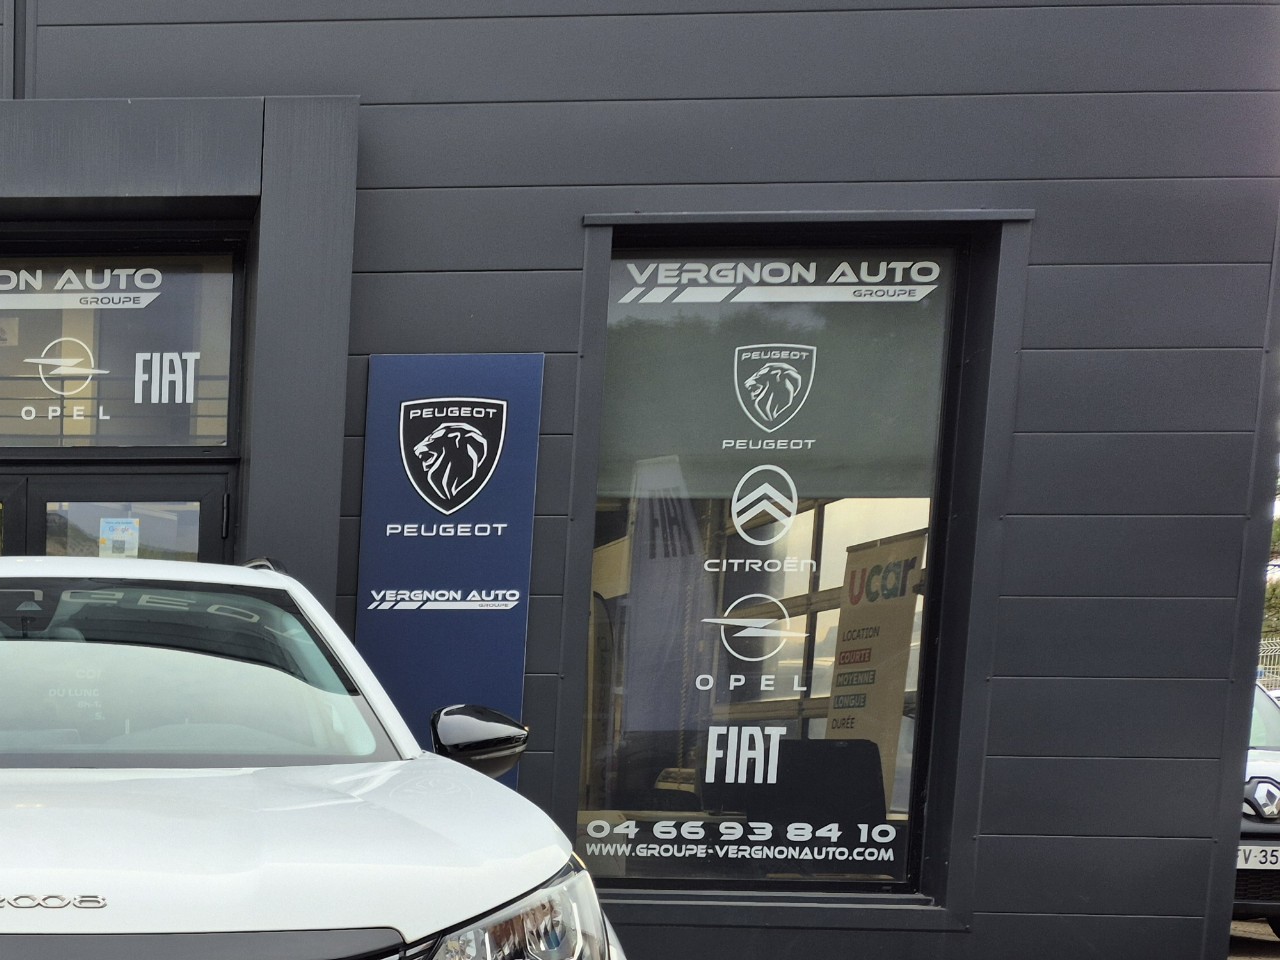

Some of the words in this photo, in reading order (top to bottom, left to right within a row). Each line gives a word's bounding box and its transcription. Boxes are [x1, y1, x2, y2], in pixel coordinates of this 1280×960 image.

[54, 267, 163, 291] AUTO
[625, 261, 818, 285] VERGNON
[826, 260, 941, 284] AUTO
[852, 288, 917, 298] GROUPE
[78, 296, 142, 306] GROUPE
[741, 350, 810, 361] PEUGEOT
[134, 351, 201, 404] FIAT
[21, 406, 111, 421] OPEL
[409, 406, 498, 420] PEUGEOT
[721, 439, 817, 450] PEUGEOT
[385, 523, 508, 537] PEUGEOT
[370, 589, 462, 601] VERGNON
[466, 589, 520, 601] AUTO
[842, 626, 881, 642] LOCATION
[839, 650, 871, 664] COURTE
[695, 674, 807, 692] OPEL
[836, 672, 875, 686] MOYENNE
[833, 694, 866, 708] LONGUE
[831, 717, 856, 730] DURÉE
[704, 725, 787, 785] FIAT
[586, 819, 640, 839] 04
[652, 820, 706, 841] 66
[718, 821, 773, 842] 93
[786, 822, 843, 843] 84
[858, 823, 897, 843] 10
[585, 842, 895, 862] WWW.GROUPE-VERGNONAUTO.COM
[1237, 848, 1280, 865] V-35
